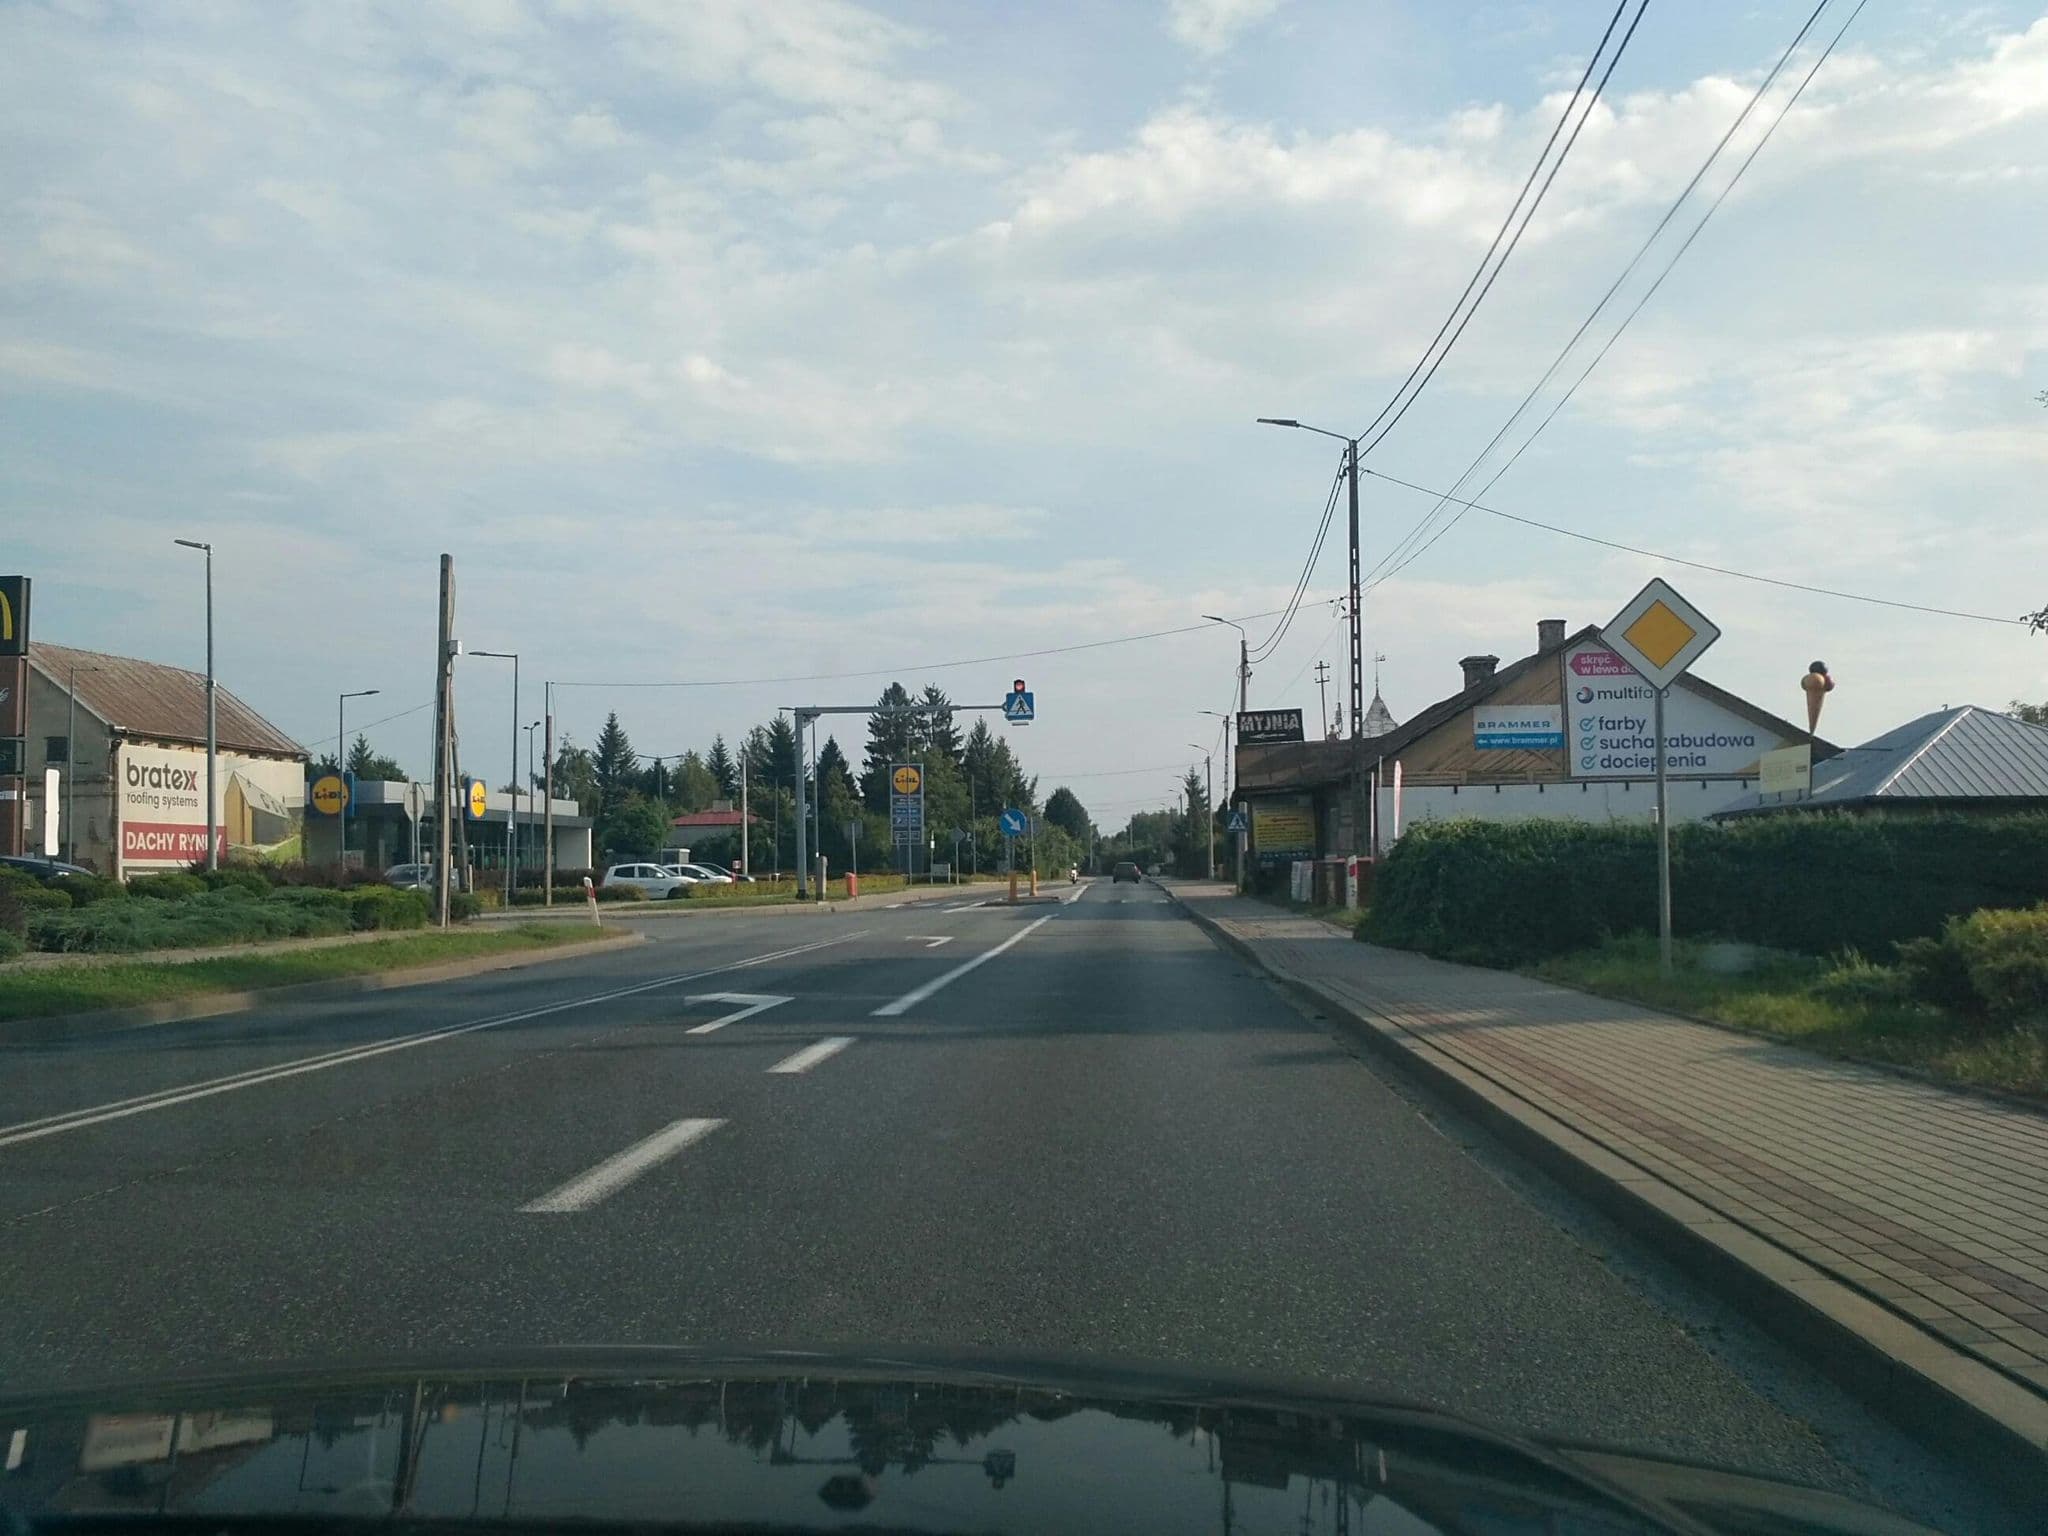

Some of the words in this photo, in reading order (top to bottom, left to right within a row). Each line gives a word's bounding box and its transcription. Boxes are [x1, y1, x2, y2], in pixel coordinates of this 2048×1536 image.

[1580, 666, 1591, 674] w
[1592, 664, 1619, 674] lewo
[1597, 686, 1670, 700] multifab
[1239, 713, 1300, 732] MYJNIA
[1477, 720, 1552, 729] BRAMMER
[1598, 716, 1647, 734] farby
[1489, 736, 1558, 746] www.brammer.pl
[1599, 735, 1655, 750] sucha
[1599, 752, 1707, 772] dociepenia
[126, 757, 198, 792] bratex
[126, 791, 160, 809] roofing
[162, 795, 199, 810] systems
[126, 831, 175, 851] DACHY
